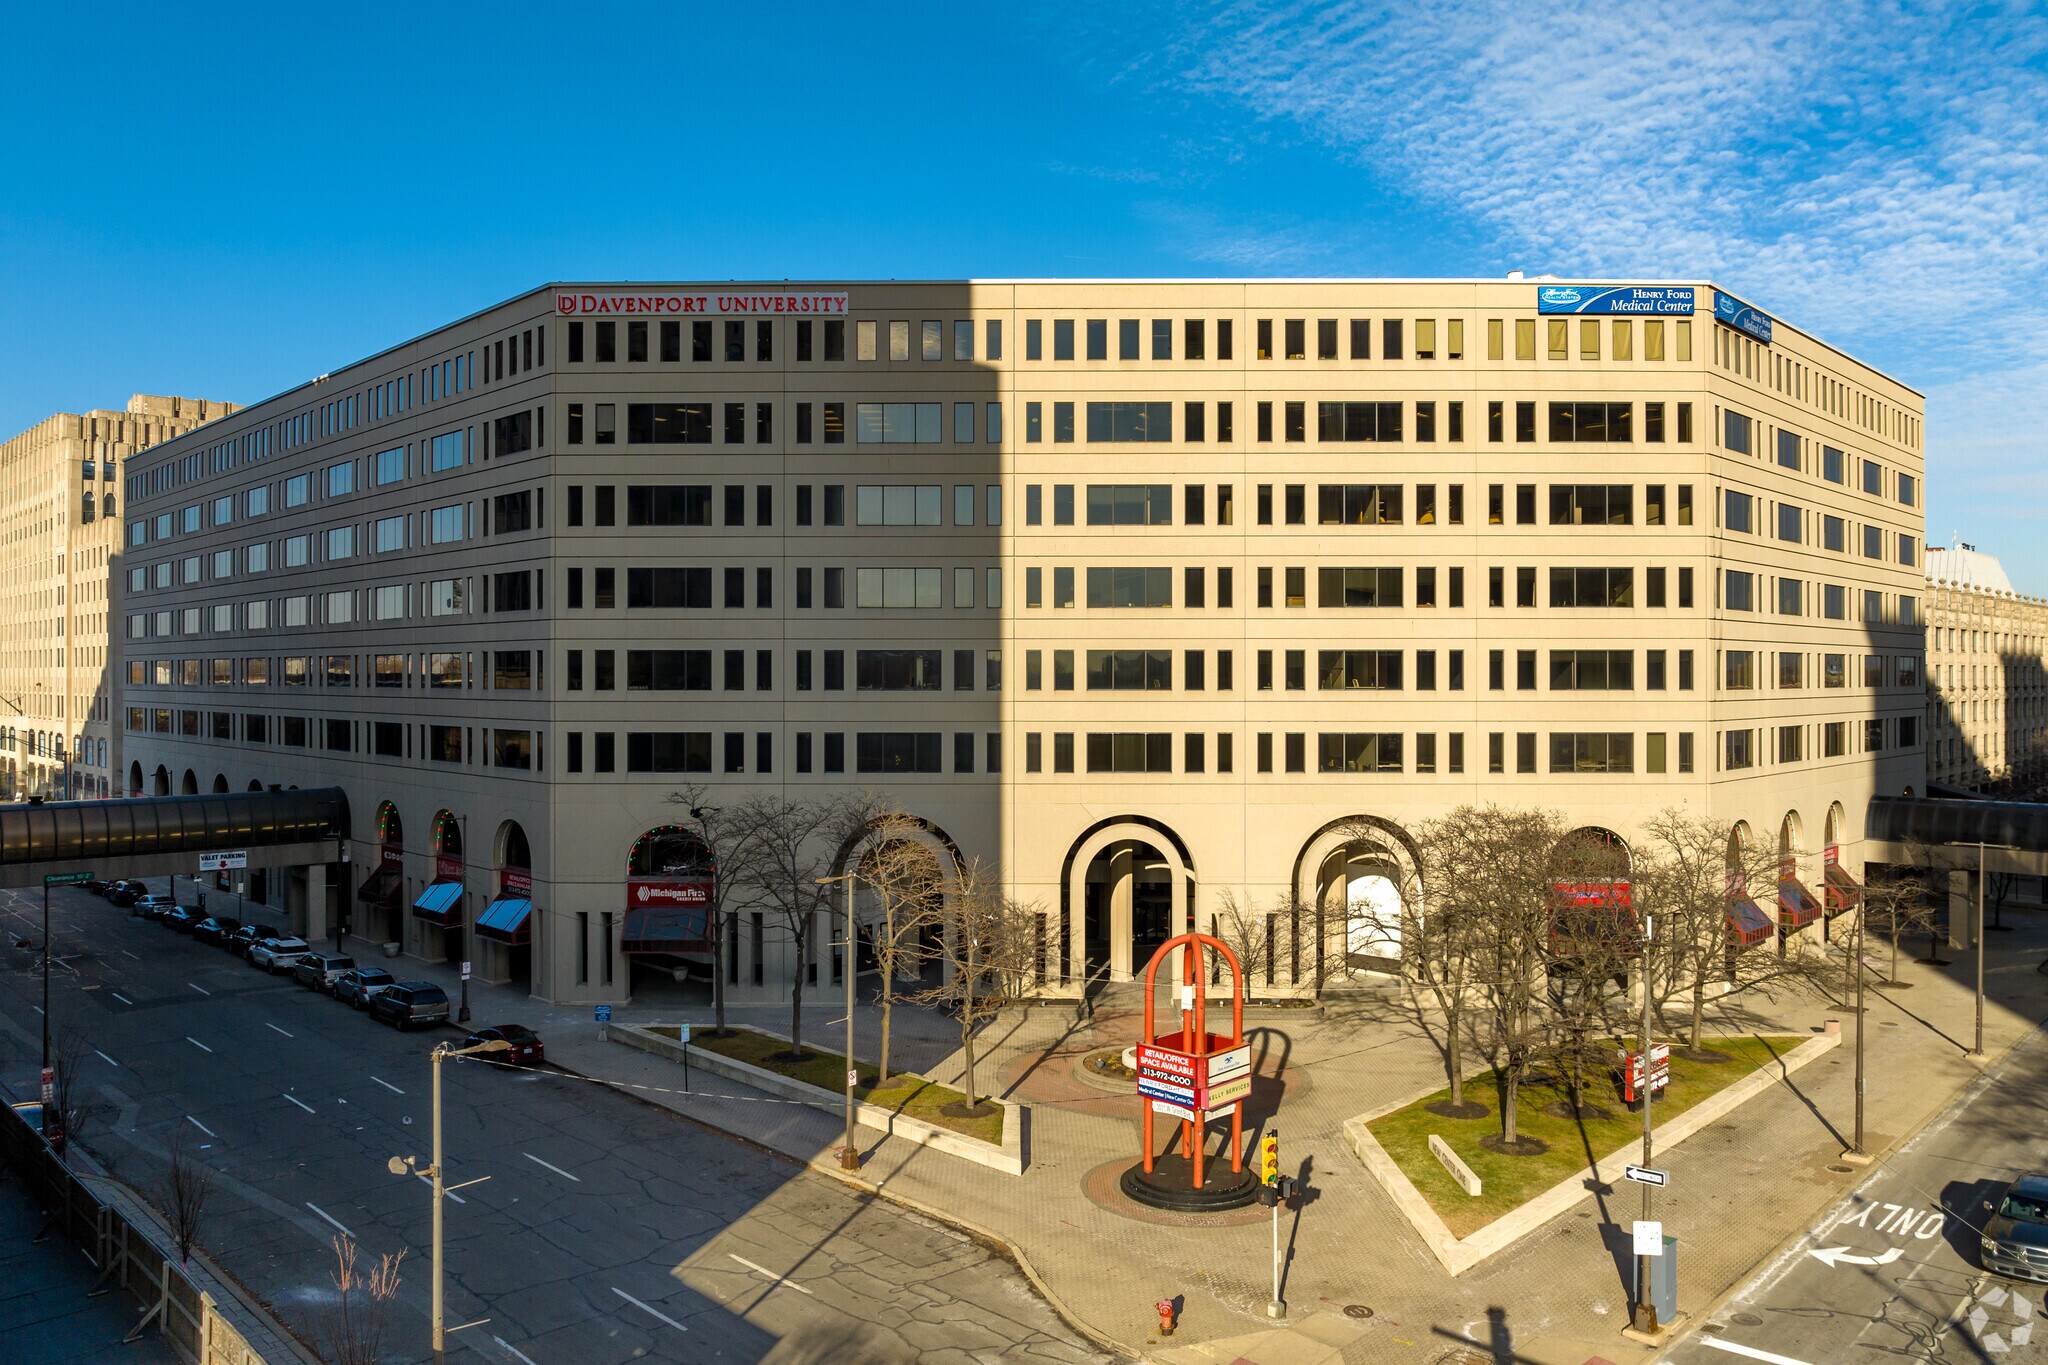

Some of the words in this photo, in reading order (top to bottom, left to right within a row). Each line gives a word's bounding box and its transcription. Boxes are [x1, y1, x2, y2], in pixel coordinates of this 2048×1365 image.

[1633, 289, 1665, 299] HENRY
[1667, 289, 1692, 299] FORD
[581, 295, 707, 313] DAVENPORT
[718, 296, 848, 312] UNIVERSITY
[1610, 299, 1654, 312] Medical
[1657, 299, 1693, 312] Center
[220, 852, 246, 860] PARKING
[650, 888, 687, 899] Michigan
[1145, 1049, 1188, 1066] RETAIL/OFFICE
[1140, 1057, 1160, 1068] SPACE
[1161, 1062, 1193, 1076] AVAILABLE
[1142, 1067, 1191, 1086] 313-972-4000
[1208, 1091, 1225, 1102] KELLY
[1225, 1082, 1250, 1096] SERVICES
[1842, 1200, 1948, 1240] ONLY
